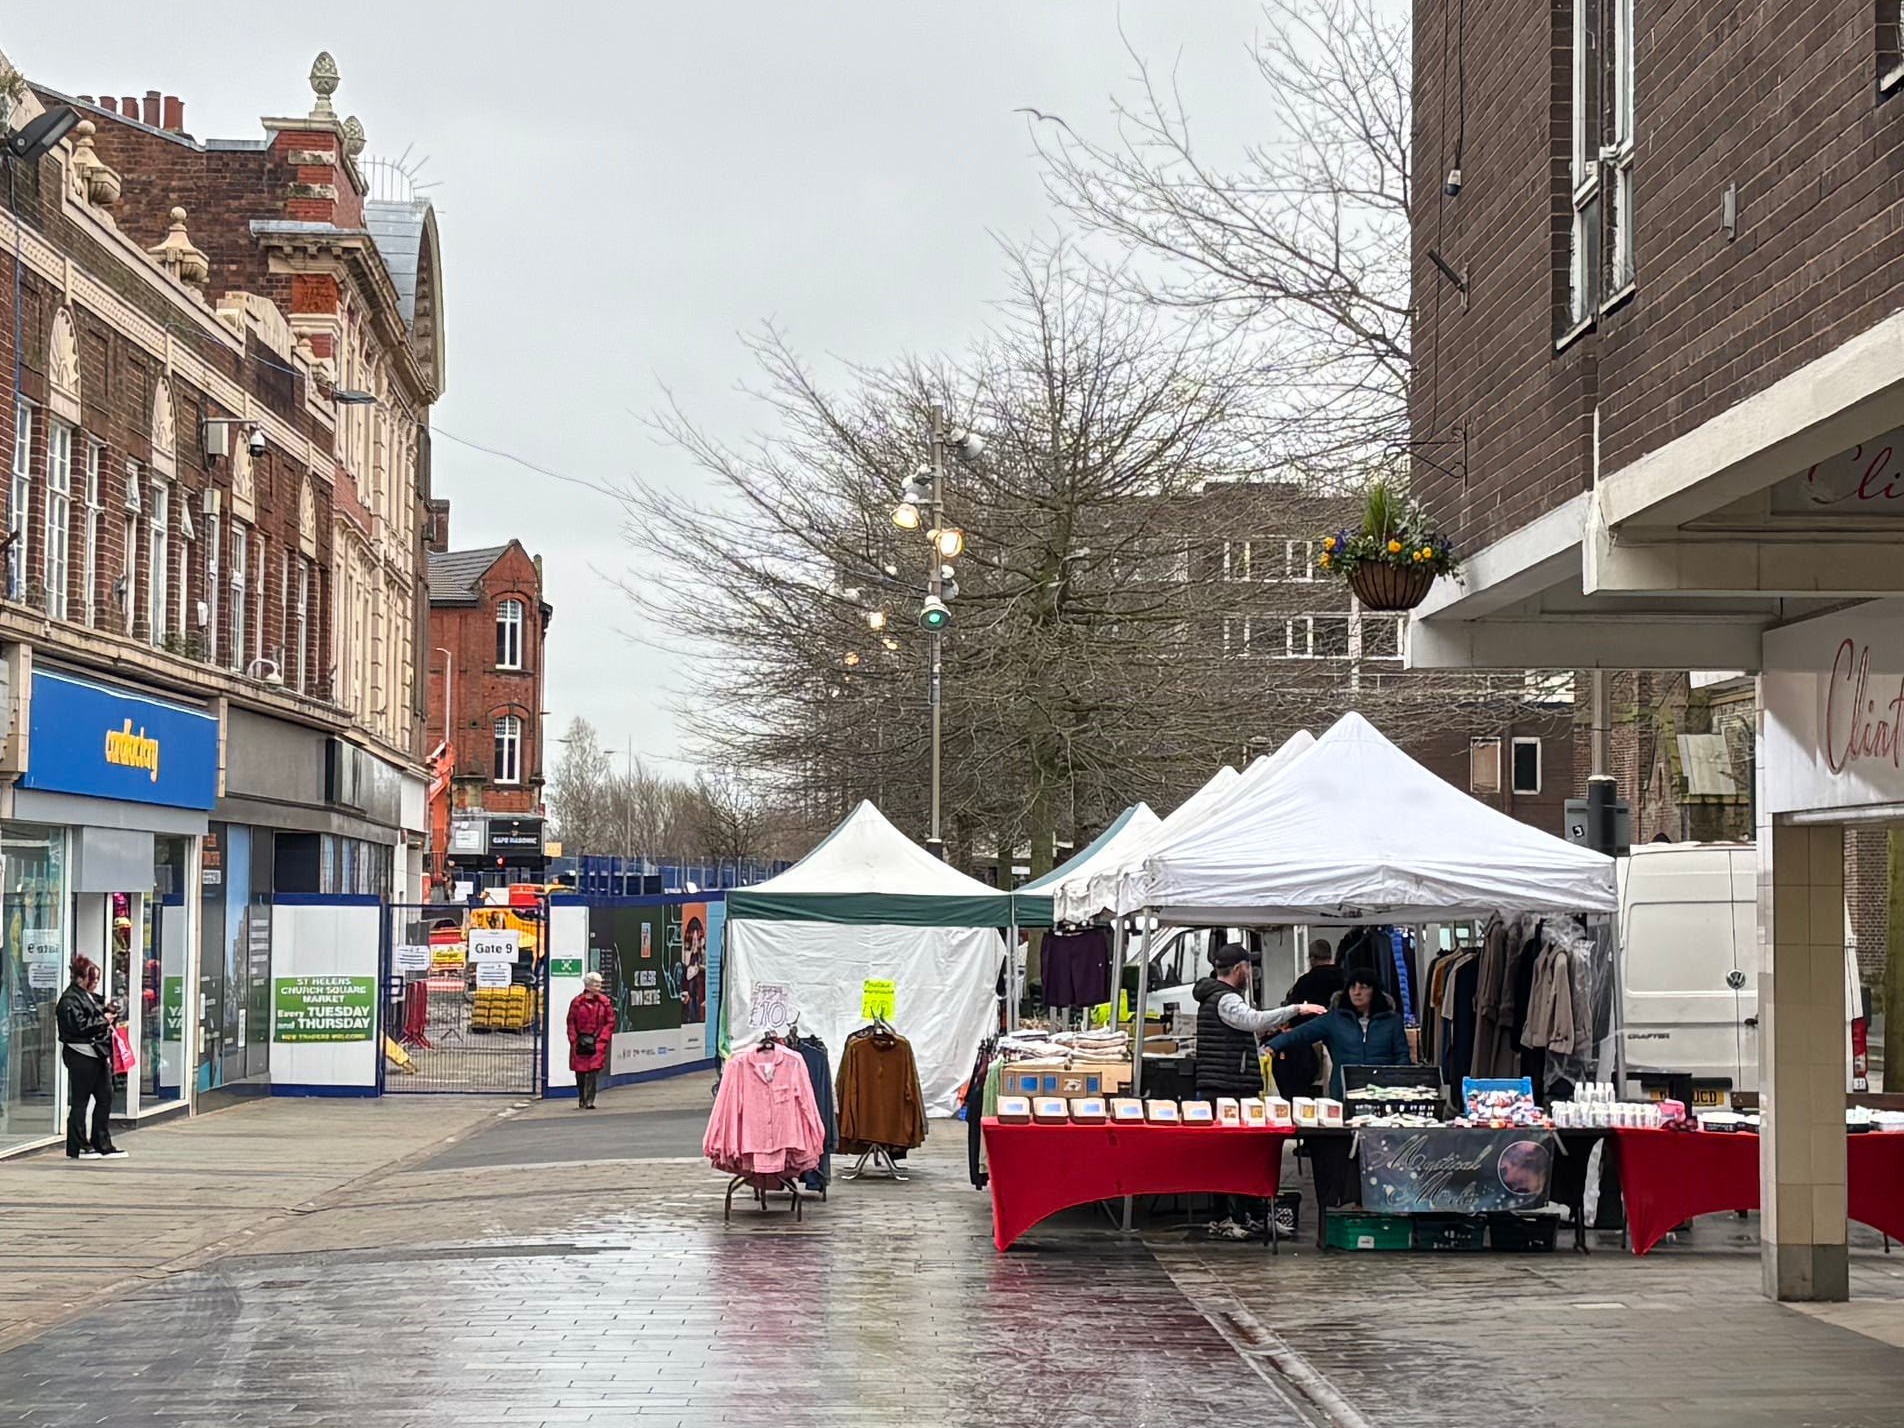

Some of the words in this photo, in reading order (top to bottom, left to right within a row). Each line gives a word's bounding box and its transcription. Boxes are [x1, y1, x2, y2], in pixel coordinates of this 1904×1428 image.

[475, 943, 502, 954] Gate
[506, 943, 513, 954] 9
[312, 977, 351, 986] HELENS
[326, 986, 366, 994] SQUARE
[303, 995, 344, 1003] MARKET
[277, 1010, 304, 1018] Every
[307, 1006, 369, 1017] TUESDAY
[277, 1021, 295, 1029] and
[298, 1018, 371, 1029] THURSDAY
